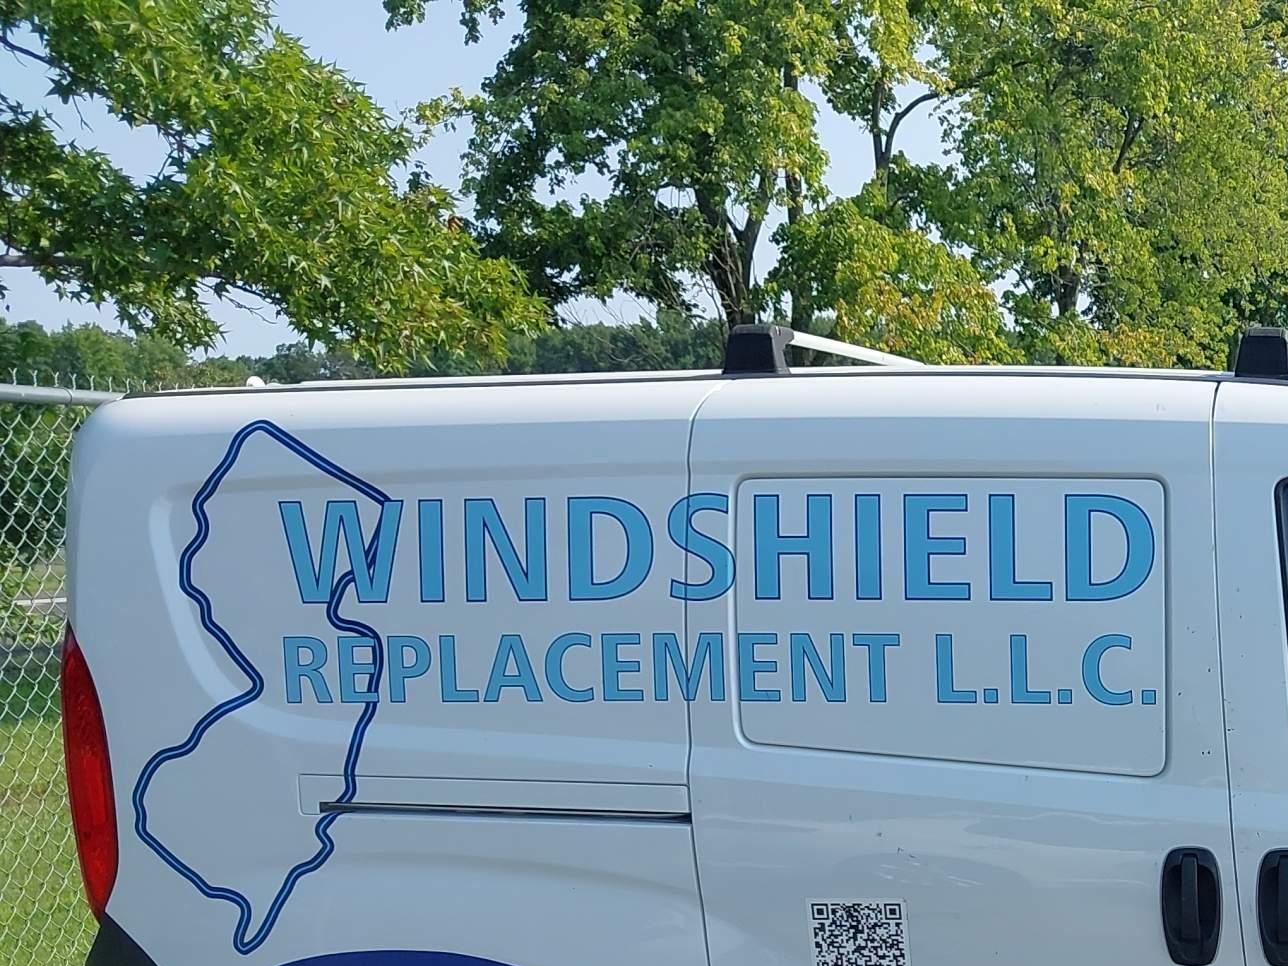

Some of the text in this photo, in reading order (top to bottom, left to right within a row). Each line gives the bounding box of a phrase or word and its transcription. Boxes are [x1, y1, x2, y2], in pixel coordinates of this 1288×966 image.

[278, 492, 1156, 604] WINDSHIELD
[282, 632, 1158, 706] REPLACEMENT L.L.C.
